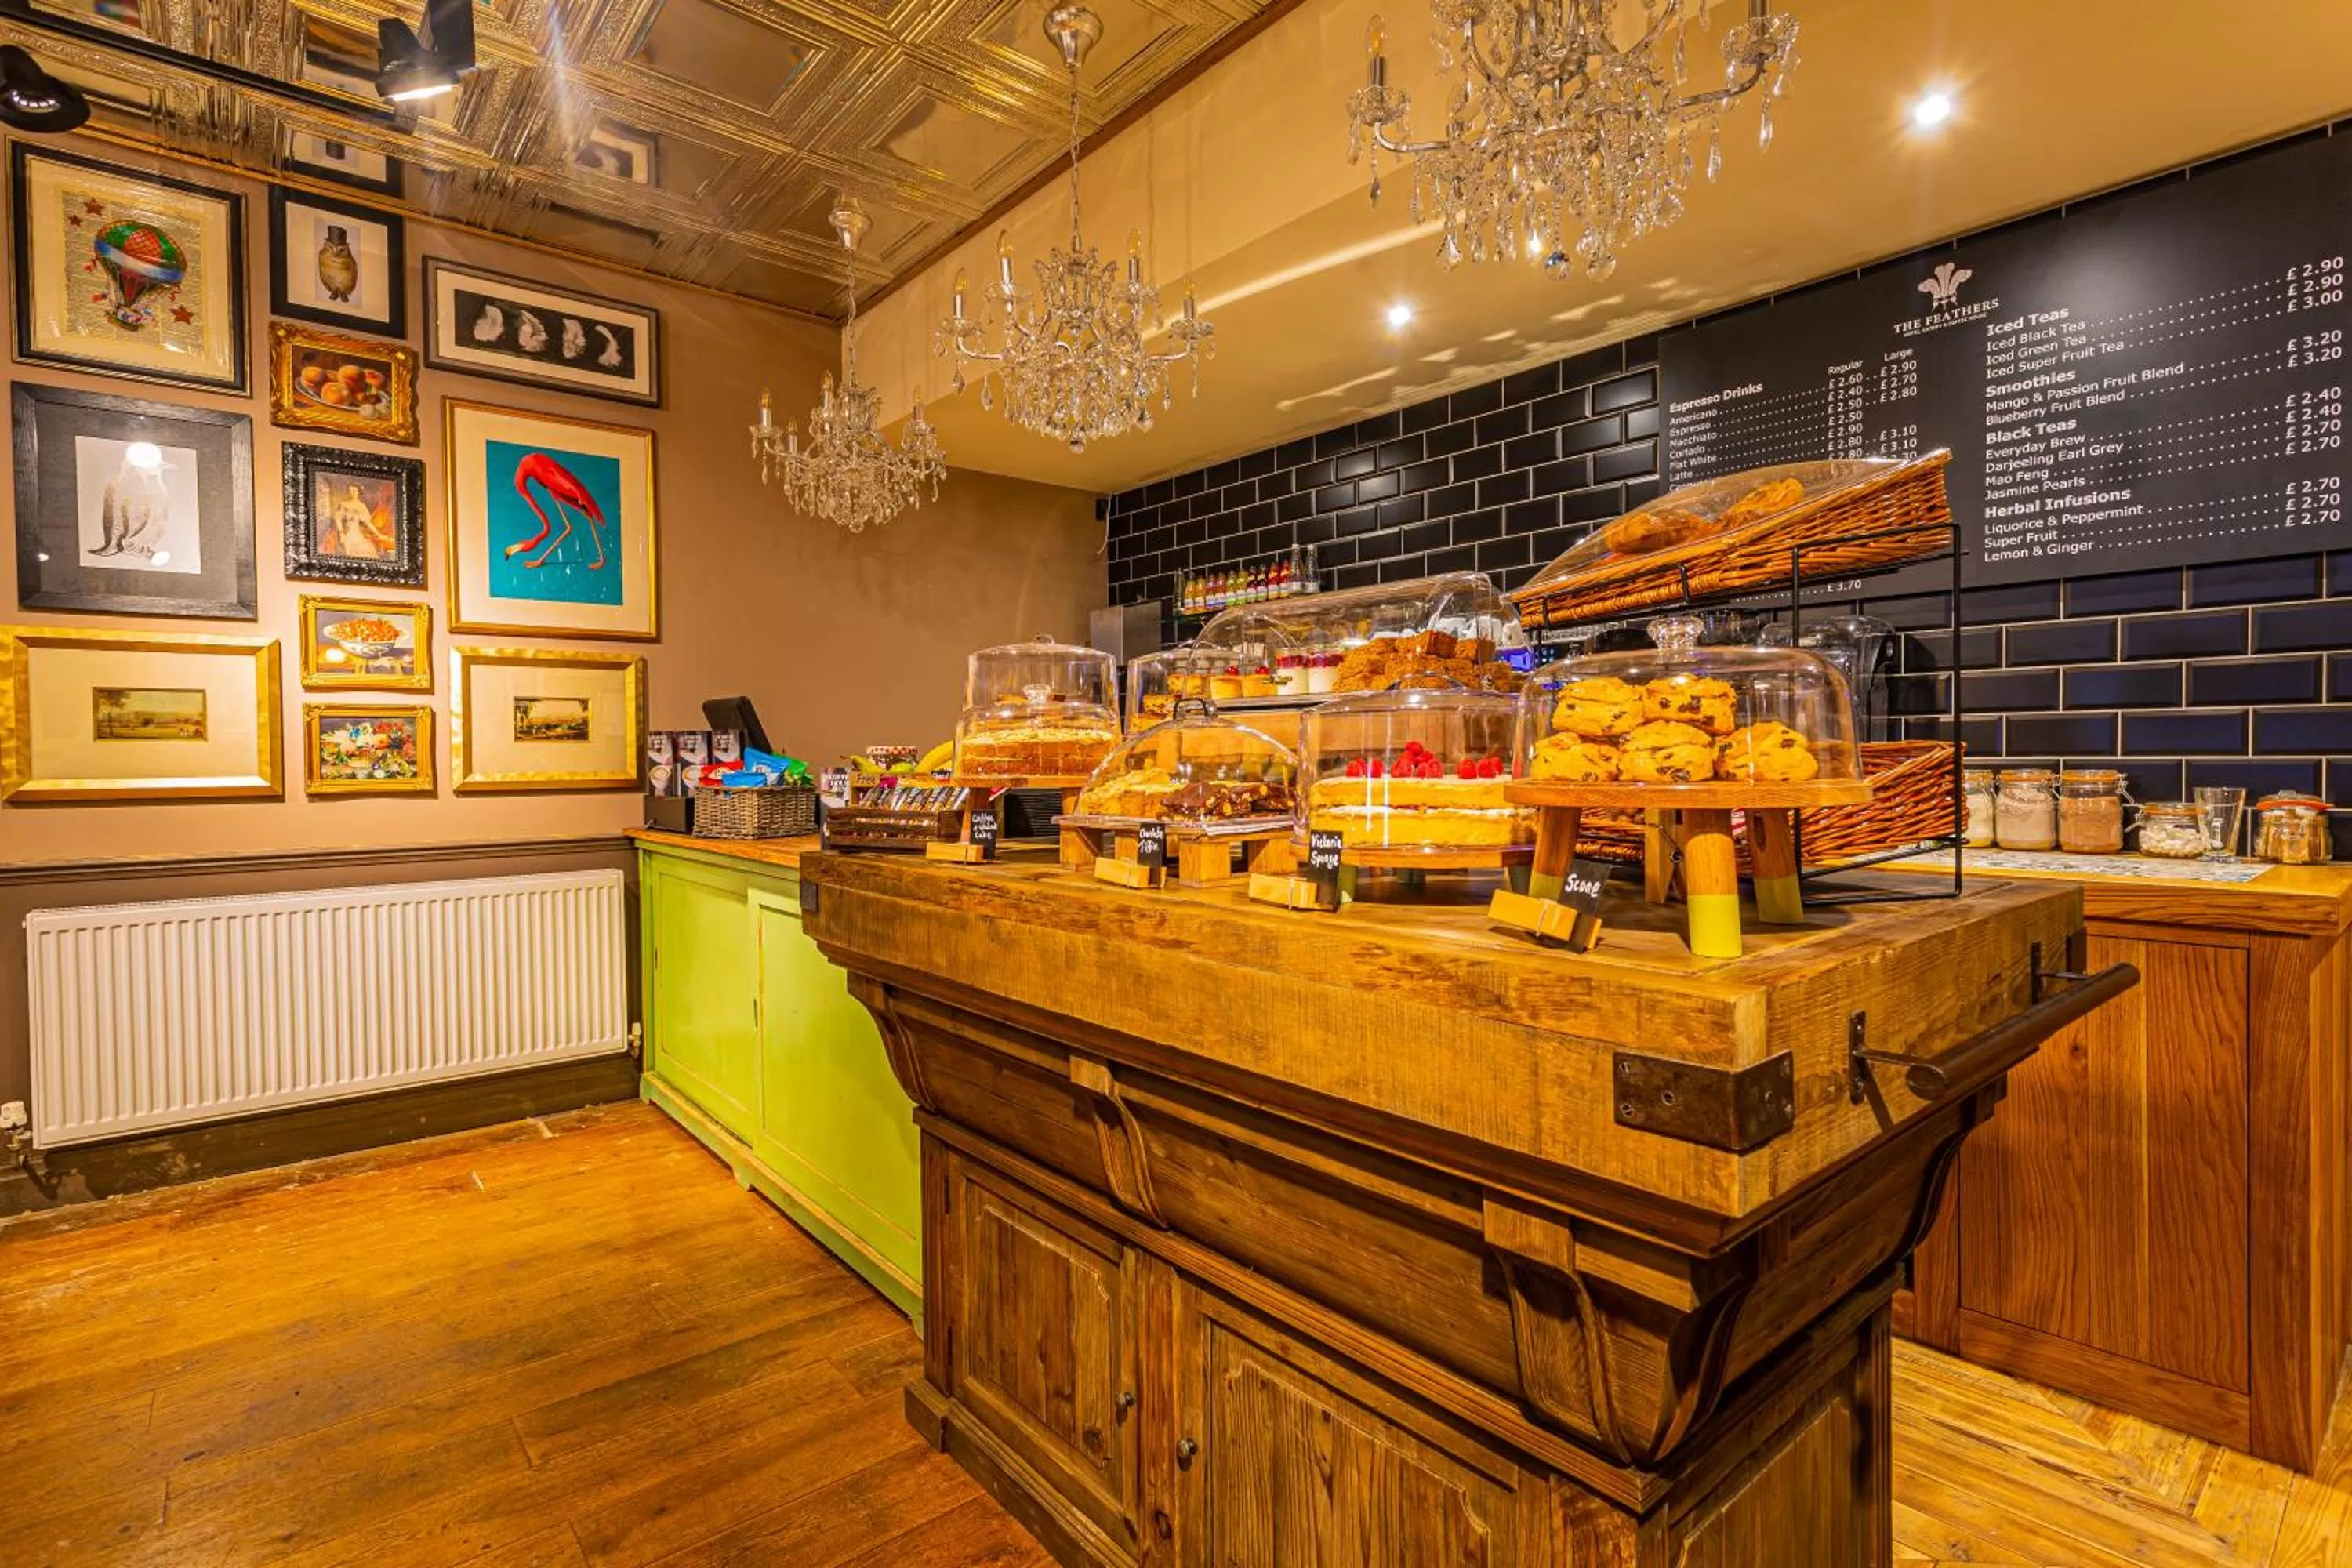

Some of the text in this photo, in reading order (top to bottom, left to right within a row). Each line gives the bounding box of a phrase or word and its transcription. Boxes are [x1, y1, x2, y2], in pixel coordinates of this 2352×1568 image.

[1894, 318, 1921, 333] THE
[1926, 298, 1998, 325] FEATHERS
[1987, 256, 2343, 351] Iced Black Tea £ 2.90
[1987, 273, 2343, 365] Iced Green Tea £ 2.90
[1987, 316, 2024, 336] Iced
[2028, 308, 2070, 325] Teas
[1828, 348, 1913, 374] Regular Large
[1987, 289, 2343, 379] Iced Super Fruit Tea £ 3.00
[1669, 360, 1917, 426] Americano £ 2.60 £ 2.90
[1669, 383, 1763, 413] Espresso Drinks
[1985, 370, 2077, 397] Smoothies
[1986, 330, 2342, 412] Mango & Passion Fruit Blend £ 3.20
[1986, 346, 2342, 426] Blueberry Fruit Blend £ 3.20
[1669, 373, 1917, 437] Espresso £ 2.40 £ 2.70
[1669, 386, 1917, 447] Macchiato £ 2.50 £ 2.80
[1986, 387, 2342, 459] Everyday Brew £ 2.40
[1986, 419, 2077, 445] Black Teas
[1669, 411, 1862, 459] Cortado £ 2.50
[1670, 423, 1863, 471] Flat White £ 2.90
[1670, 424, 1917, 482] Latte £ 2.80 £ 3.10
[1880, 443, 1887, 454] £
[1890, 437, 1917, 451] 3.10
[1985, 419, 2342, 486] Mao Feng £ 2.70
[1986, 402, 2342, 474] Darjeeling Earl Grey £ 2.40
[1984, 435, 2340, 500] Jasmine Pearls £ 2.70
[1984, 488, 2132, 518] Herbal Infusions
[1984, 477, 2340, 535] Liquorice & Peppermint £ 2.70
[1984, 492, 2340, 549] Super Fruit £ 2.70
[1984, 509, 2340, 562] Lemon & Ginger £ 2.70
[1311, 851, 1338, 869] Sponge
[1312, 834, 1341, 848] Victoria
[1564, 873, 1601, 898] Scone
